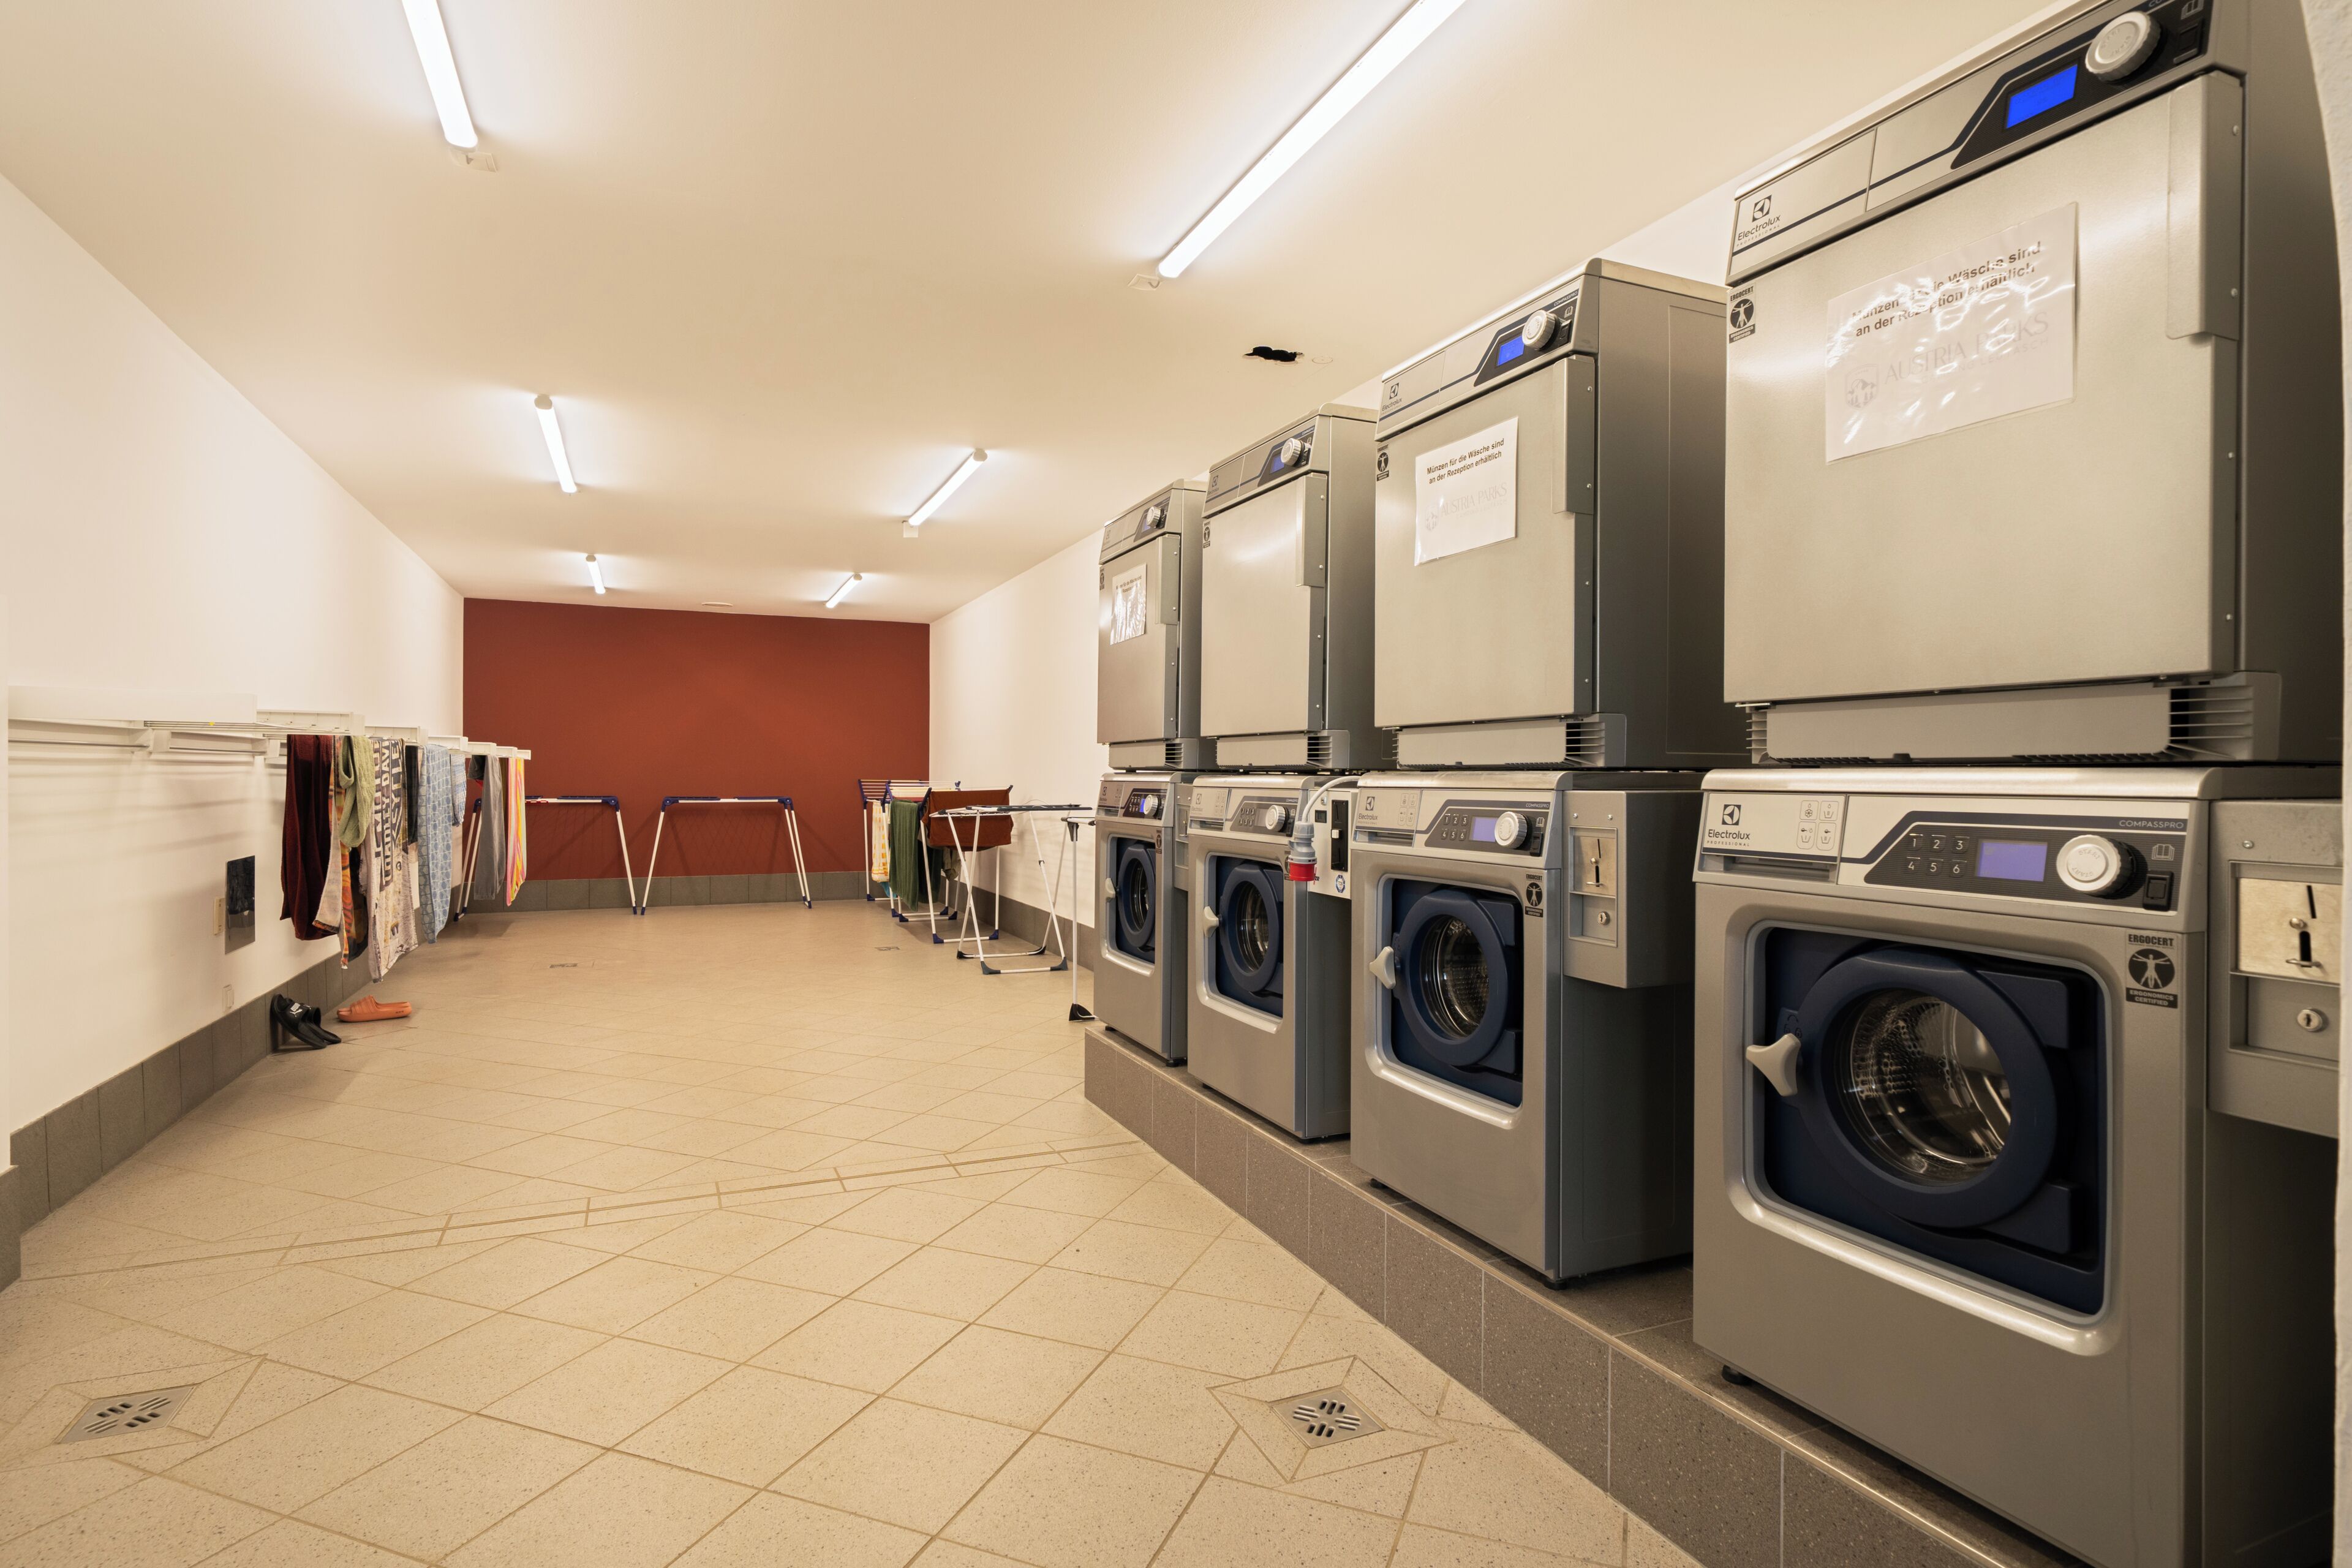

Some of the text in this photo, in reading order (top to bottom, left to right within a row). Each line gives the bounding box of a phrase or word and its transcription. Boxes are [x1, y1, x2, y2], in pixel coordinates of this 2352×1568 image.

[1738, 214, 1781, 241] Electrolux
[2009, 241, 2041, 263] sind
[1730, 286, 1754, 302] ERGOCERT
[1856, 325, 1871, 337] an
[1874, 316, 1895, 330] der
[1885, 341, 1967, 385] AUSTRIA
[1382, 398, 1403, 412] Electrolux
[1427, 438, 1504, 475] Münzen für die Wäsche sind
[1437, 472, 1446, 481] der
[1447, 462, 1474, 478] Rezeption
[1475, 451, 1502, 467] erhältlich
[1441, 495, 1476, 516] AUSTRIA
[1478, 482, 1507, 504] PARKS
[2119, 820, 2184, 829] COMPASSPRO
[1708, 829, 1751, 840] Electrolux
[1913, 839, 1963, 850] 1 2 3
[1908, 861, 1960, 873] 4 5 6
[2128, 934, 2174, 947] ERGOCERT
[2130, 990, 2174, 1000] ERGONOMICS
[2135, 997, 2169, 1006] CERTIFIED
